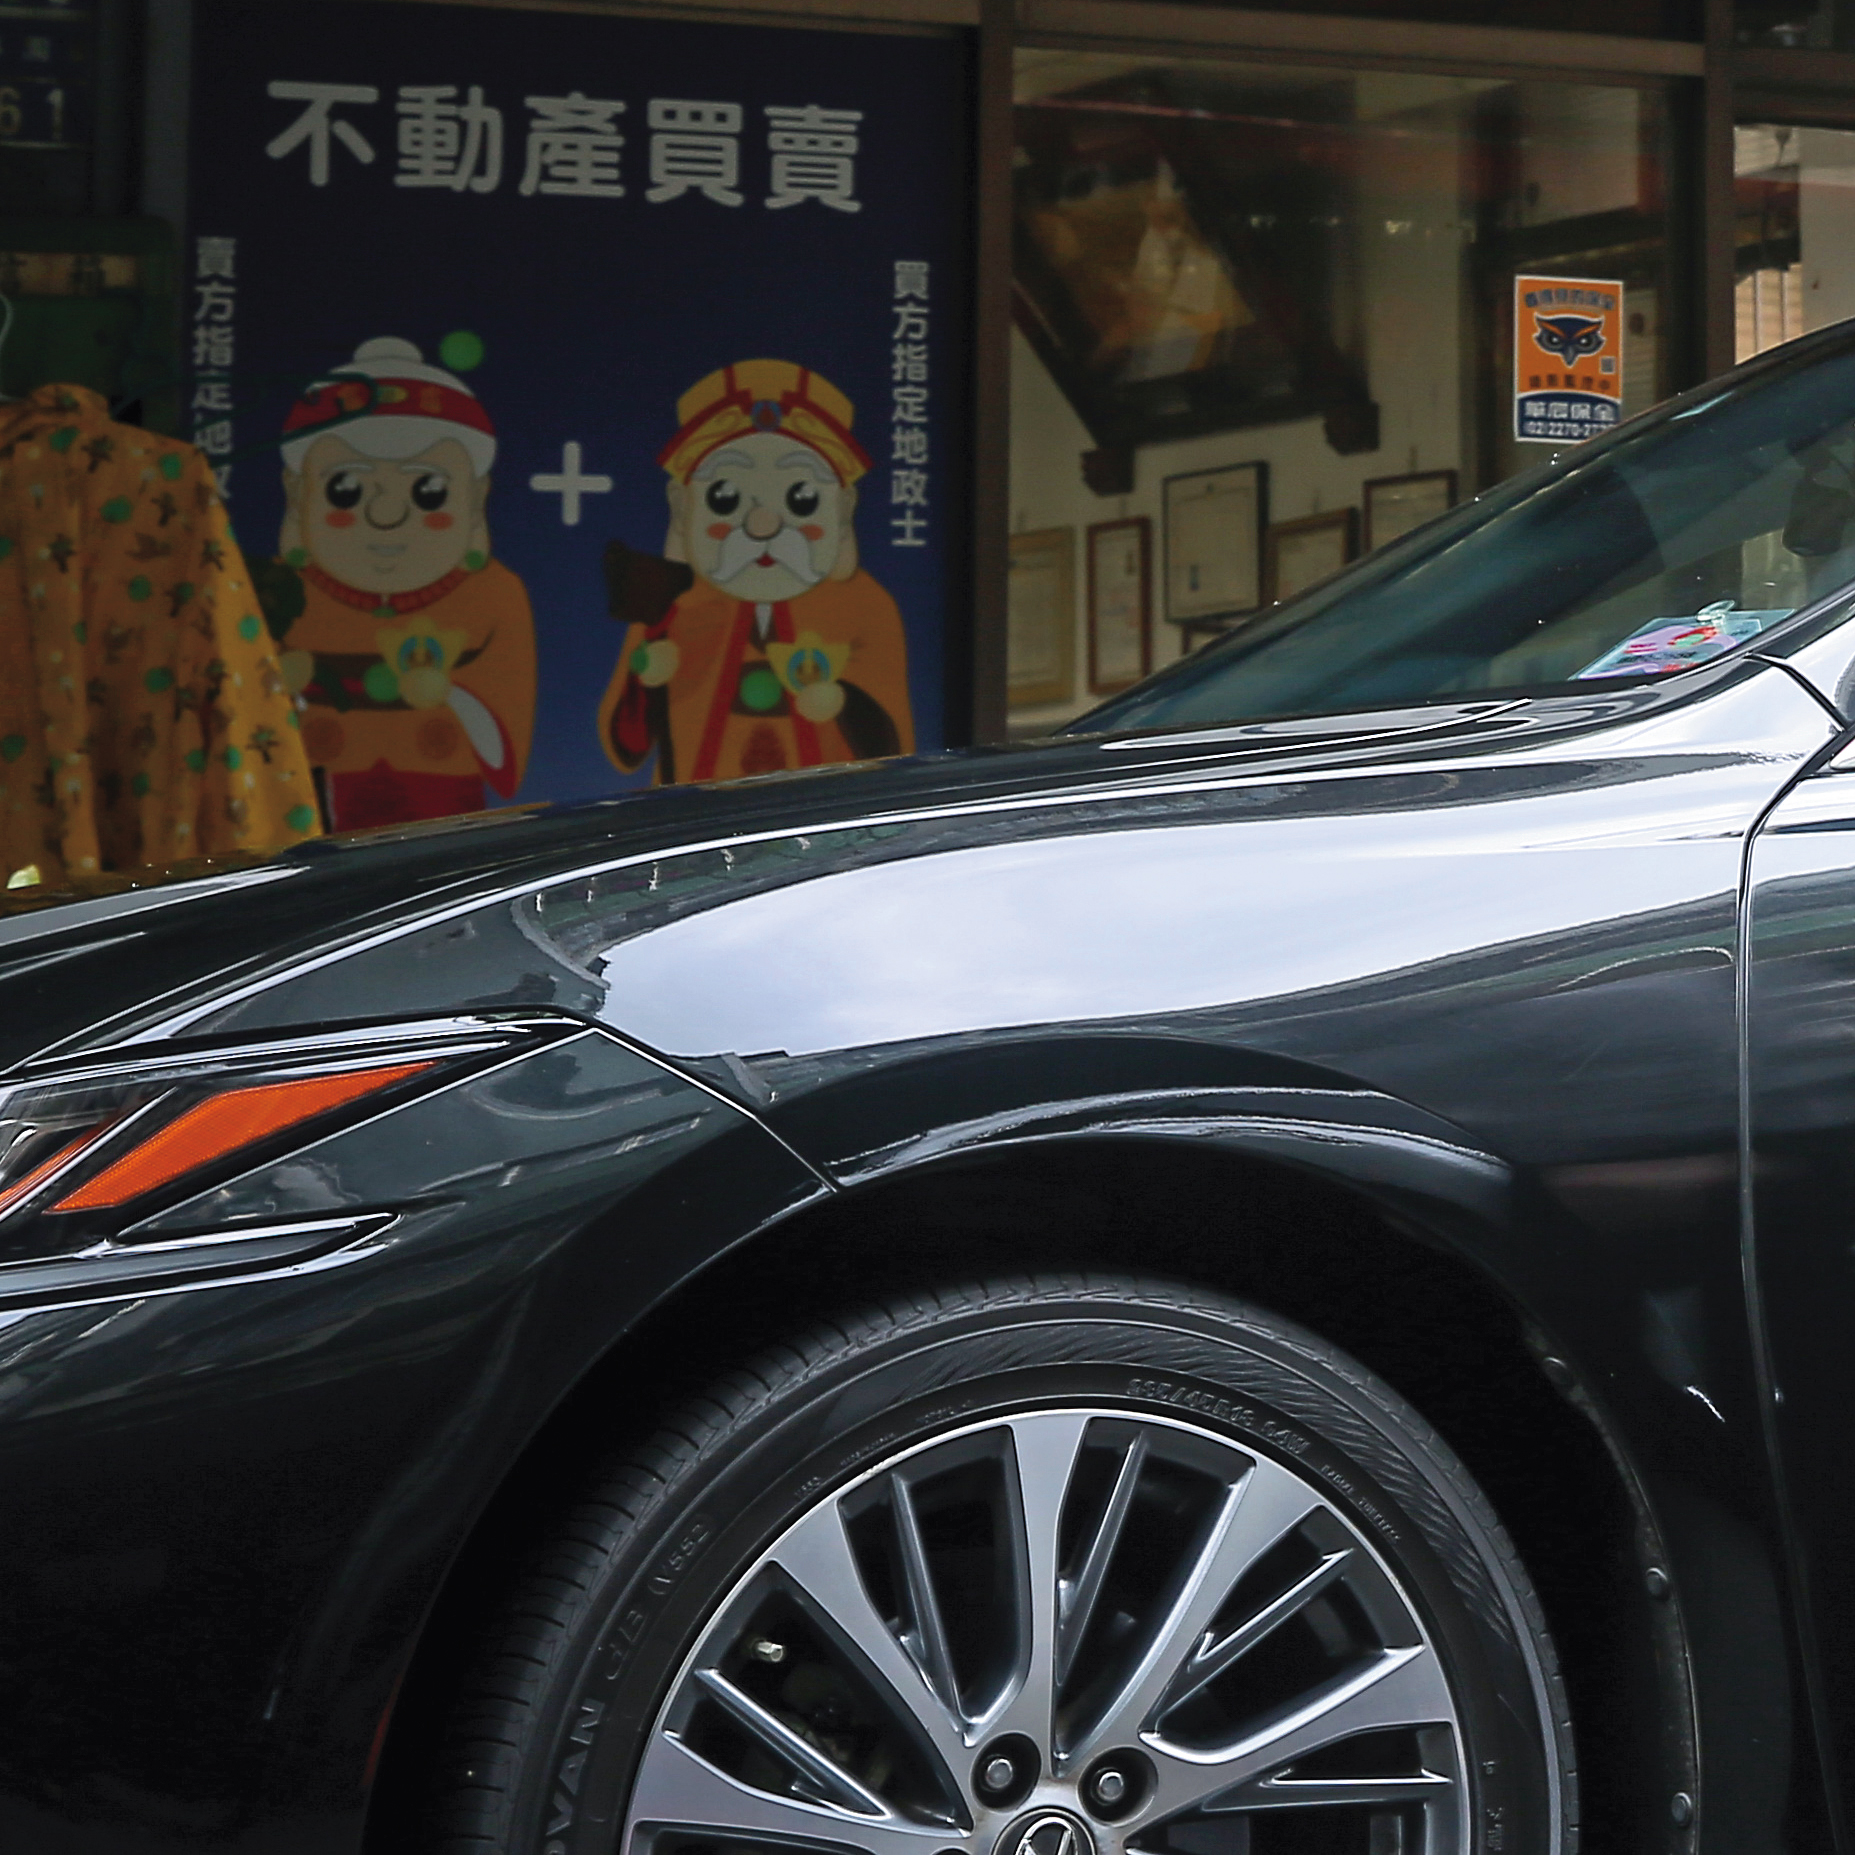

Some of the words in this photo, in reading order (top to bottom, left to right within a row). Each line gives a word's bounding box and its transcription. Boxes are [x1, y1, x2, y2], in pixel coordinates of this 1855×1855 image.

[265, 79, 864, 213] 不動產買賣
[890, 259, 931, 548] 買方指定地政士
